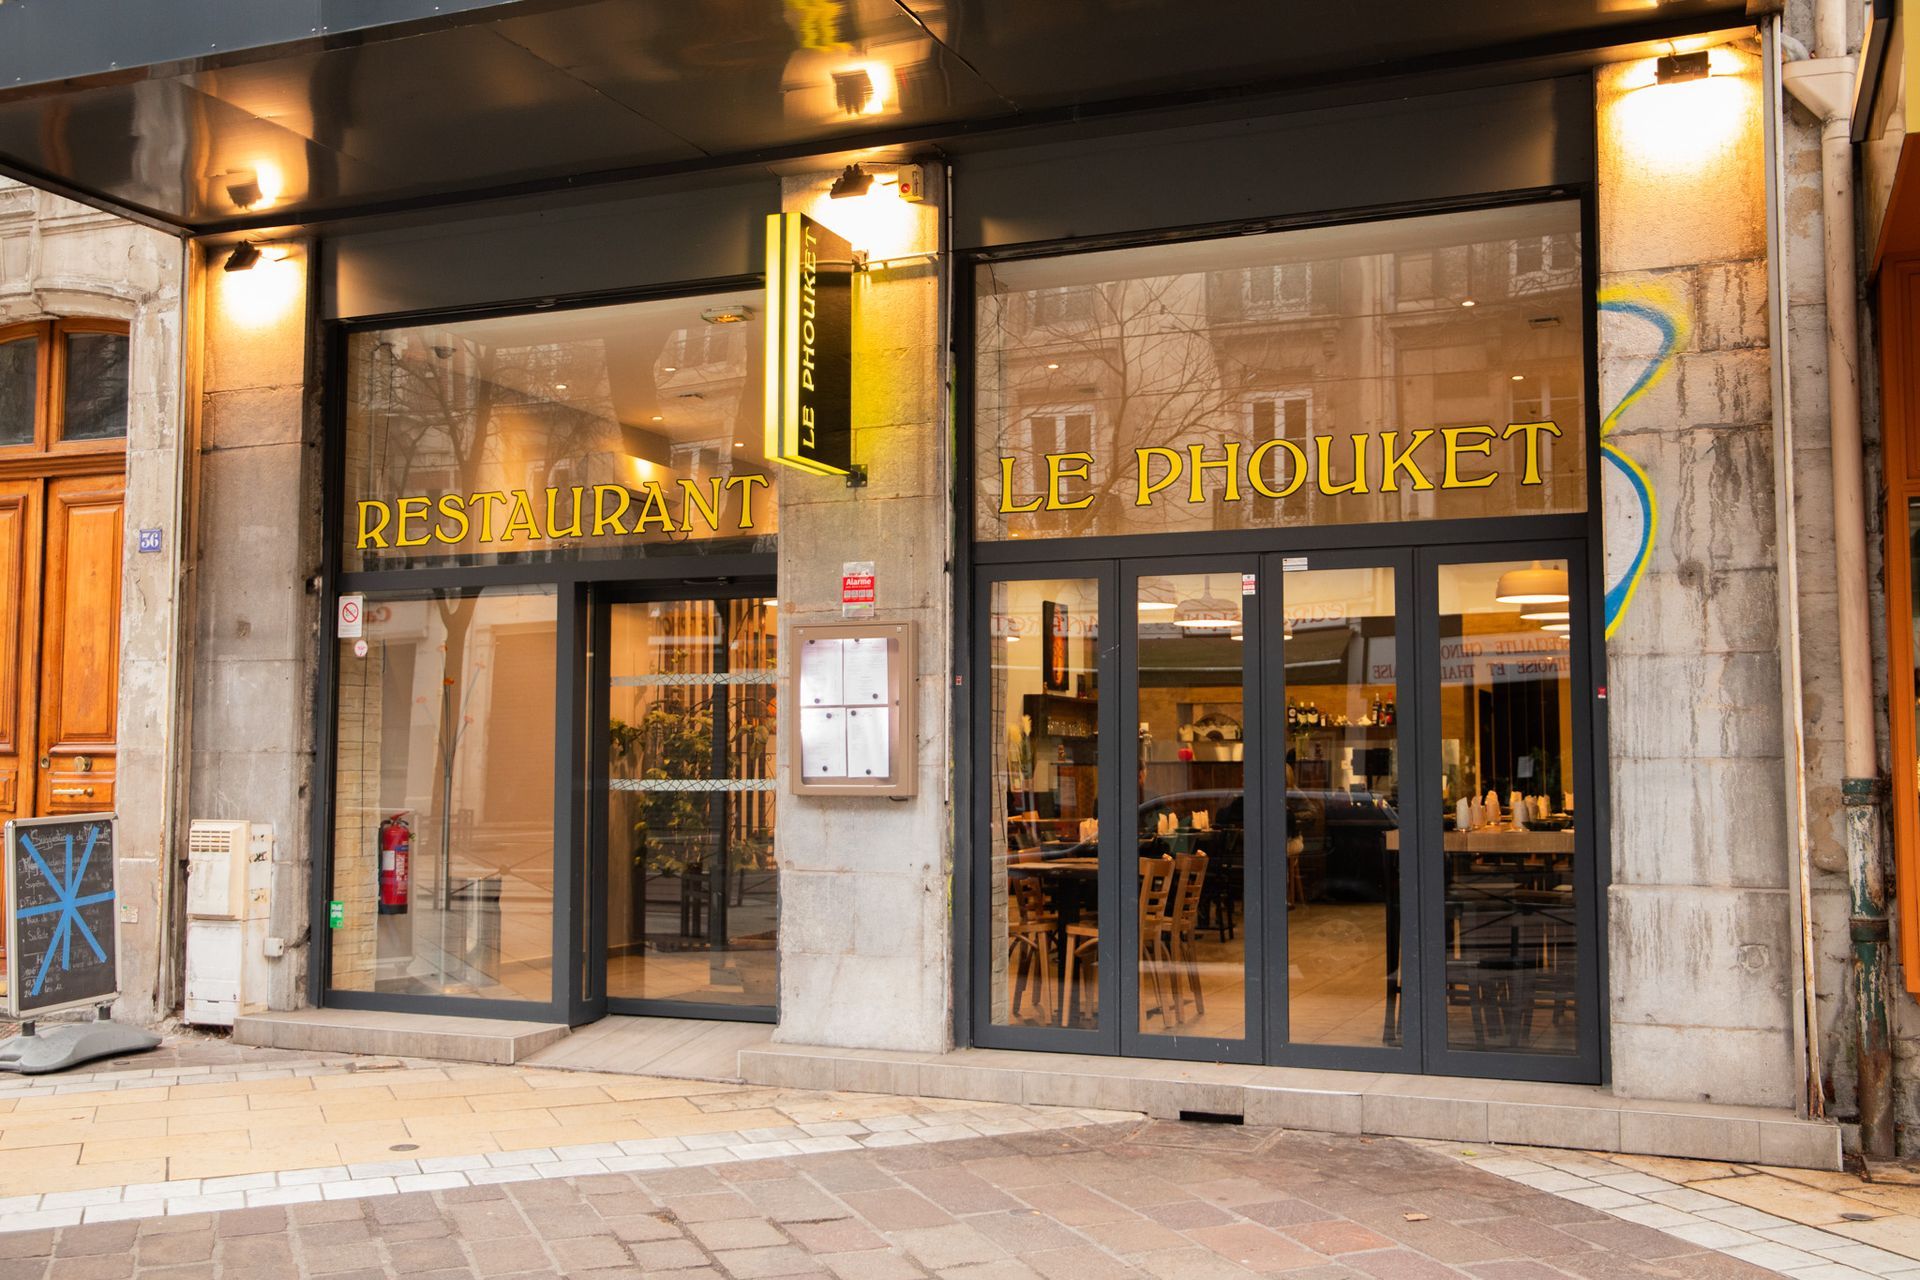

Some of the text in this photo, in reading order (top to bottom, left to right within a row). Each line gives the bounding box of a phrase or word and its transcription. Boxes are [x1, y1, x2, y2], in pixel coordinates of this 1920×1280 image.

[801, 226, 818, 450] LE PHOUKET
[998, 420, 1564, 515] LE PHOUKET
[355, 474, 770, 550] RESTAURANT
[845, 577, 872, 586] Alarme
